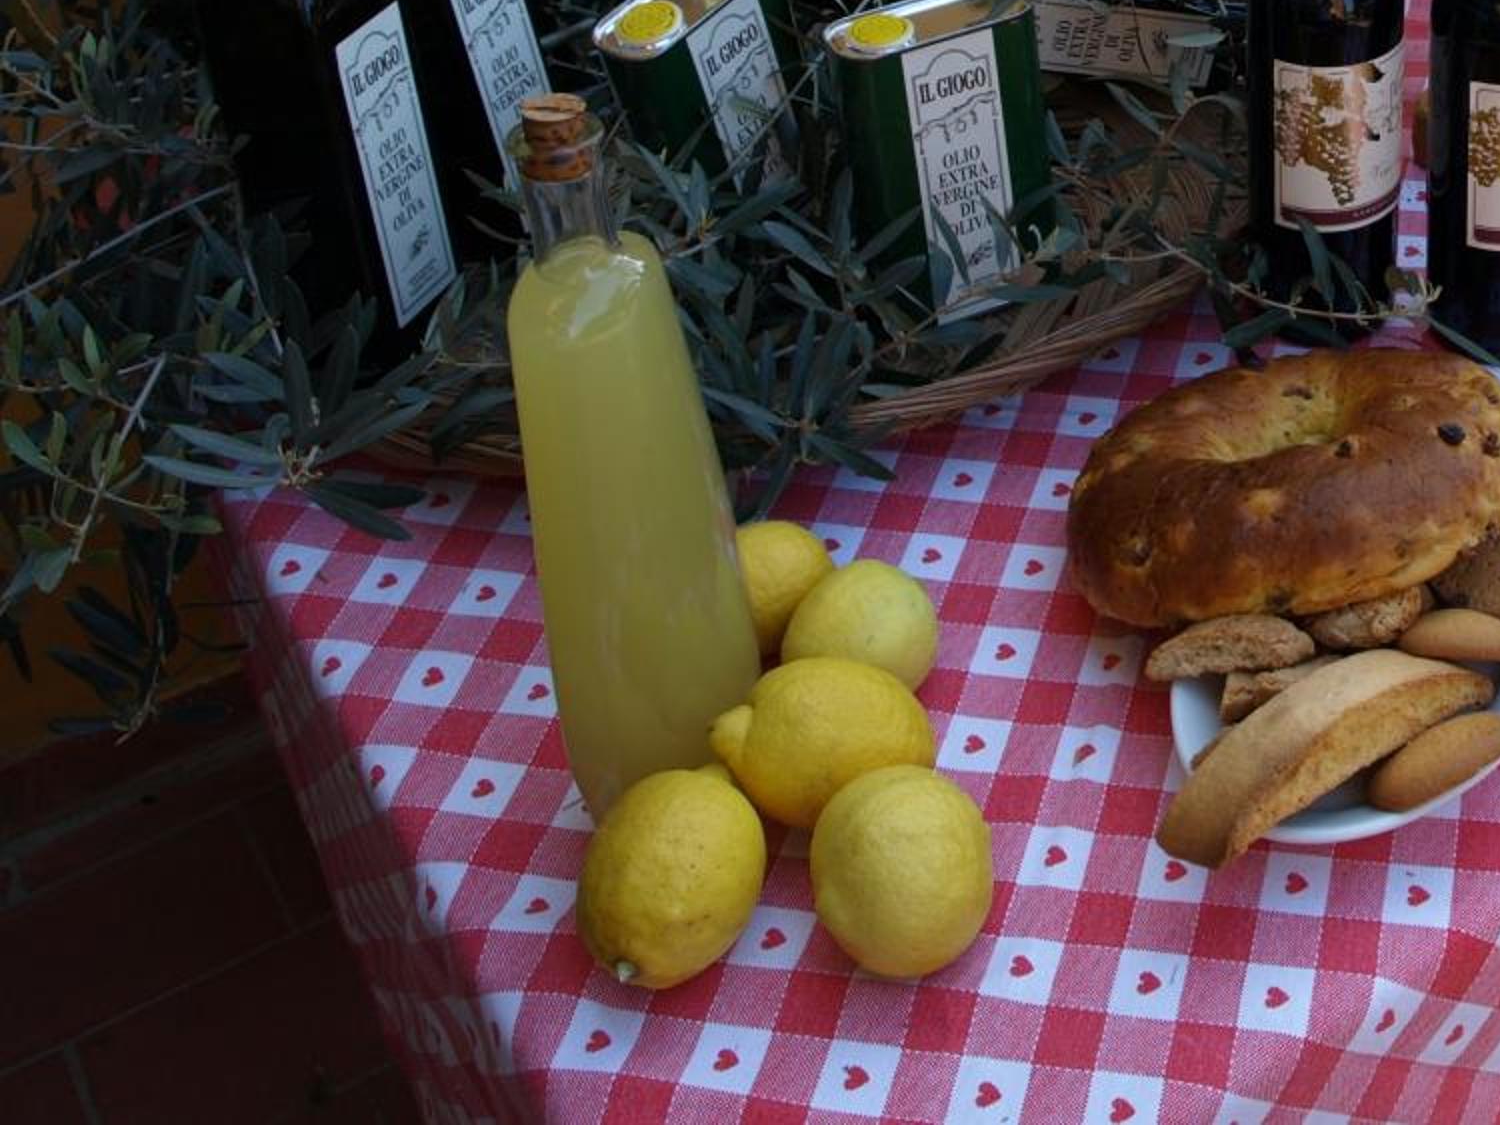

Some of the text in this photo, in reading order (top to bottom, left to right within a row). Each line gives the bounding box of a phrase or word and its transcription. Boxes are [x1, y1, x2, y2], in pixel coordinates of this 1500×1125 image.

[706, 23, 758, 76] IL GIOGO
[352, 43, 399, 97] IL GIOGO
[493, 61, 529, 94] EXTRA
[919, 66, 986, 104] IL GIOGO
[379, 127, 407, 160] OLIO
[942, 143, 981, 169] OLIO
[376, 154, 424, 204] VERGINE
[380, 142, 415, 183] EXTRA
[938, 159, 989, 190] EXTRA
[933, 174, 999, 207] VERGINE
[960, 197, 977, 218] DI
